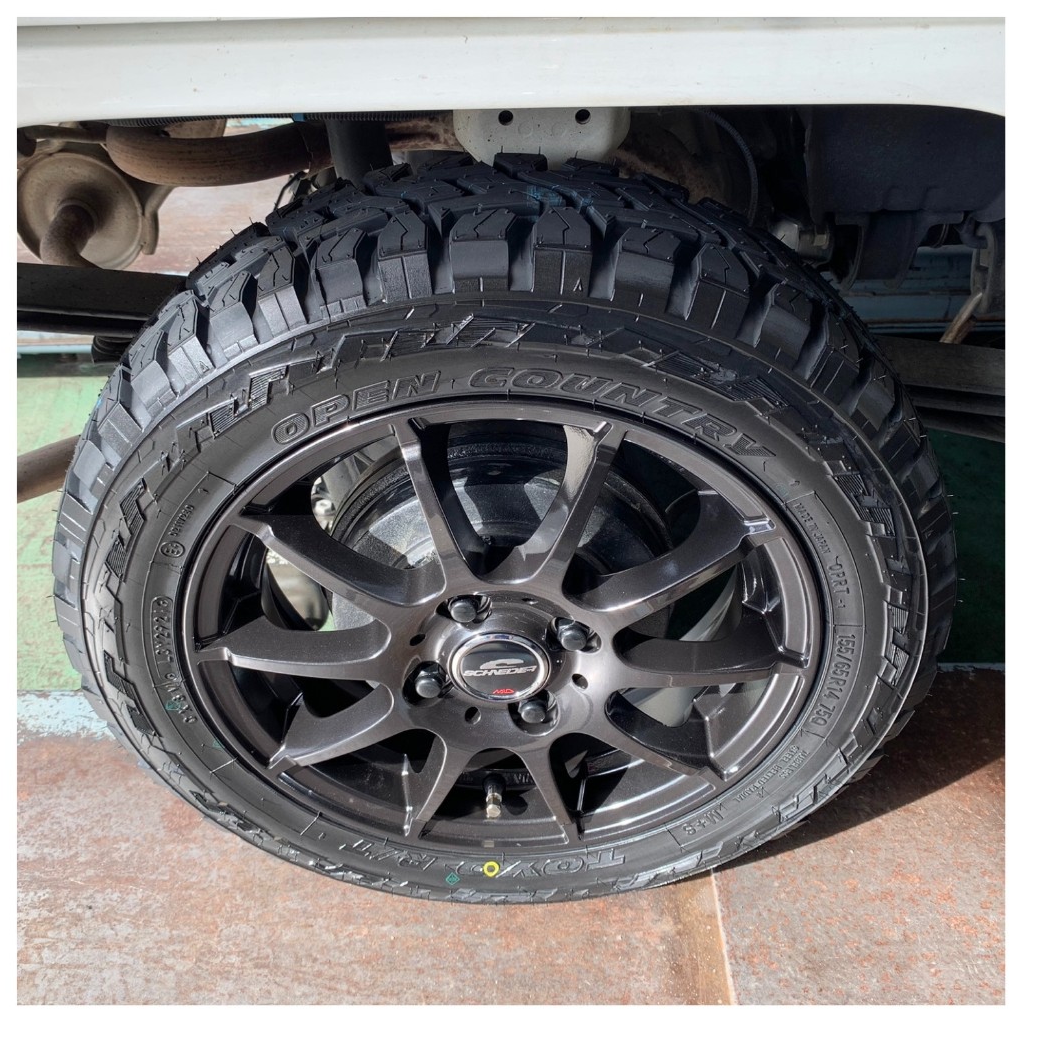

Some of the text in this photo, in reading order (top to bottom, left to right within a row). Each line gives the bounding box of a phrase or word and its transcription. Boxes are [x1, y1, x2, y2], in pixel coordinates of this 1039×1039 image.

[271, 367, 776, 457] OPEN COUNTRY
[828, 563, 850, 594] OPRT
[810, 634, 856, 727] 155/65R14 75Q
[455, 848, 626, 879] TOYO
